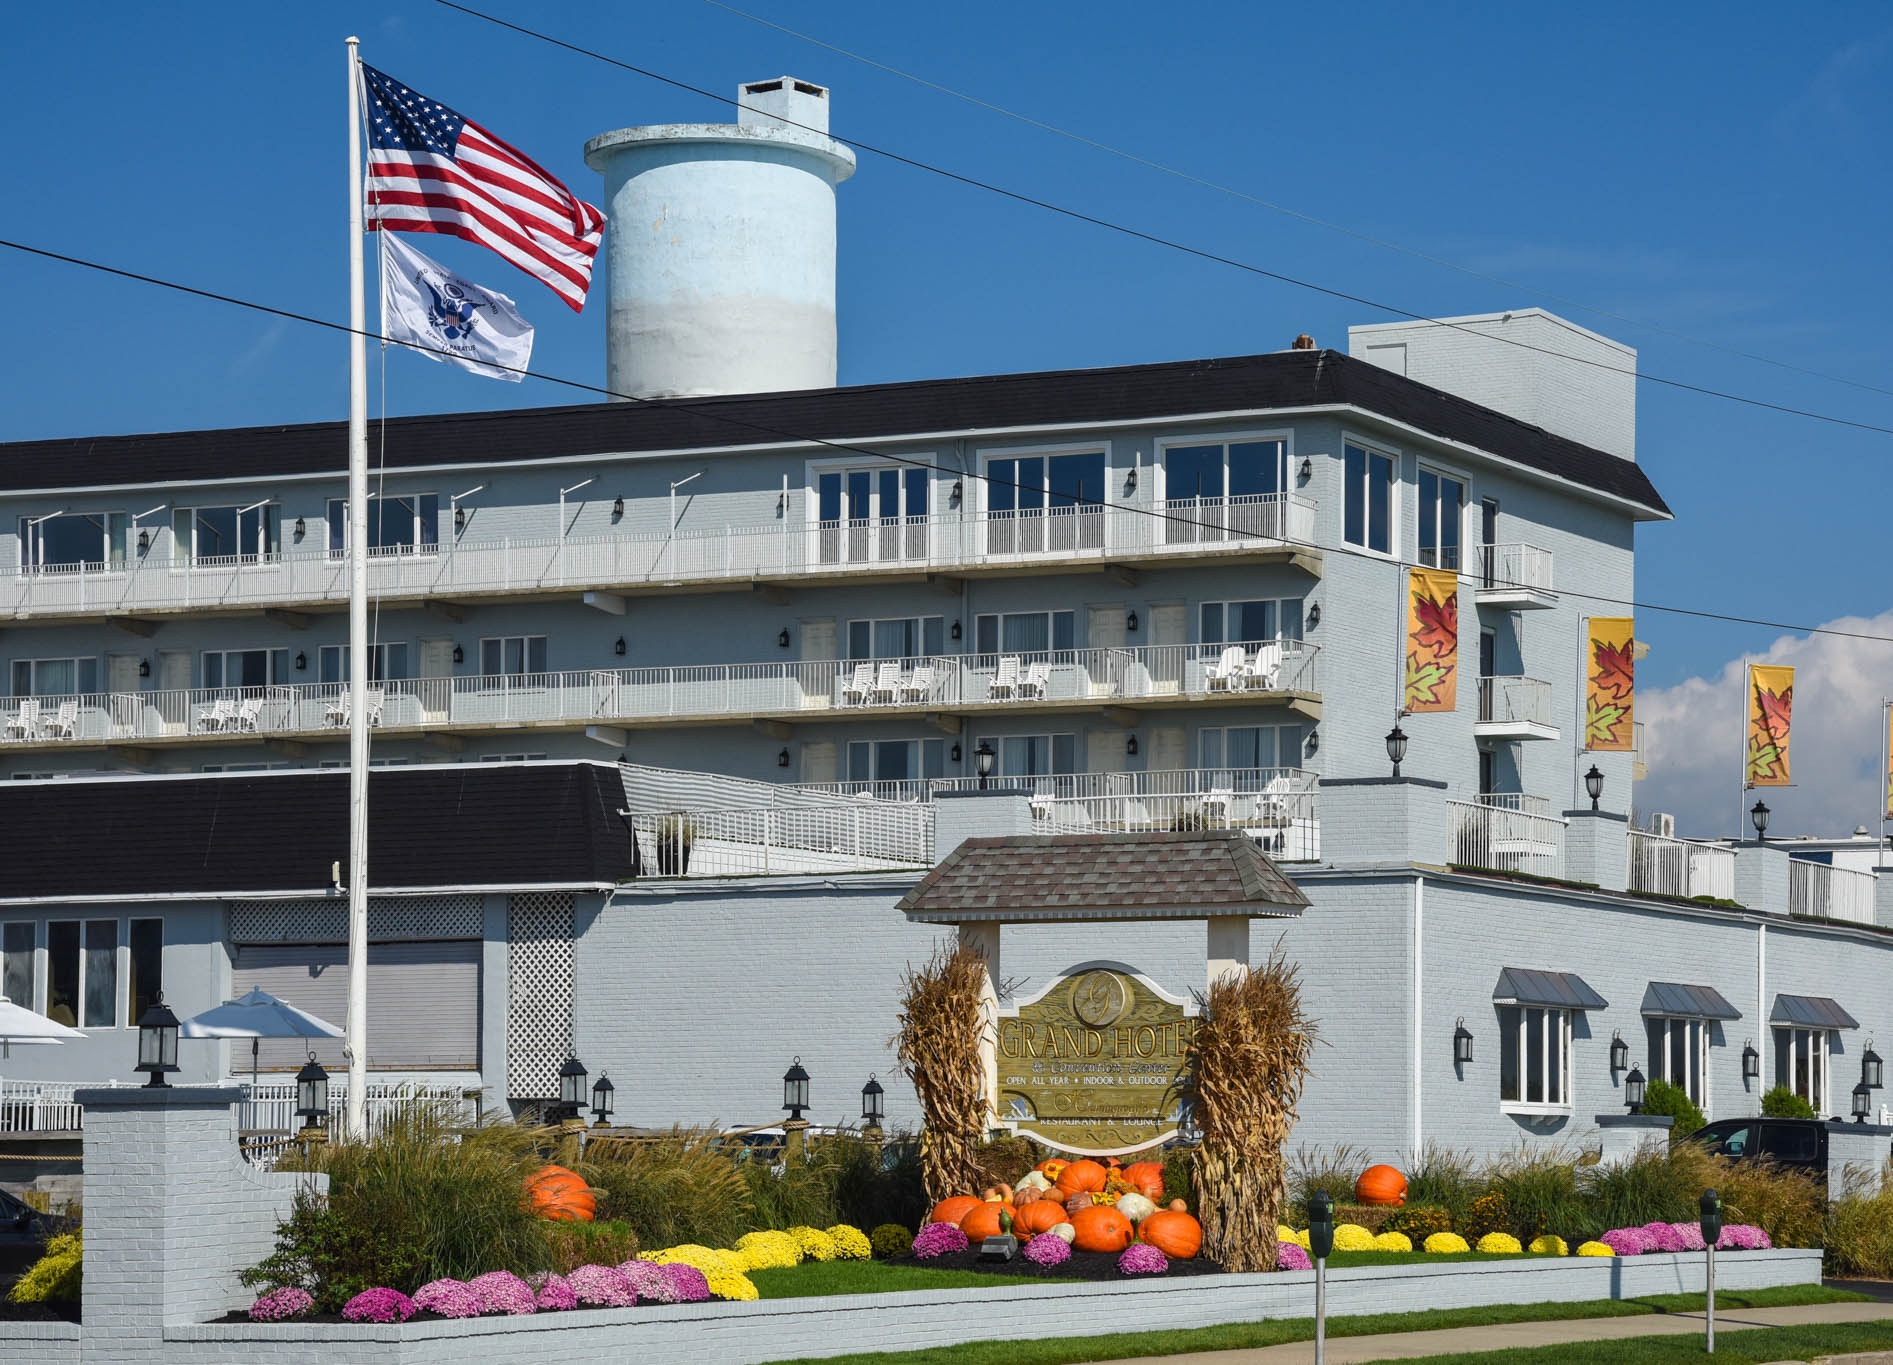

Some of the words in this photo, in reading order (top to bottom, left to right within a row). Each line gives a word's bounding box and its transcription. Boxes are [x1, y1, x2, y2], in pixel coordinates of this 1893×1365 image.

[1000, 1019, 1103, 1058] GRAND
[1050, 1061, 1121, 1074] Convention
[1128, 1061, 1172, 1074] Center
[1006, 1076, 1026, 1085] OPEN
[1031, 1076, 1045, 1085] ALL
[1049, 1076, 1069, 1085] YEAR
[1083, 1076, 1114, 1085] INDOOR
[1118, 1076, 1124, 1085] &
[1128, 1076, 1168, 1085] OUTDOOR
[1039, 1118, 1102, 1126] RESTAURANT
